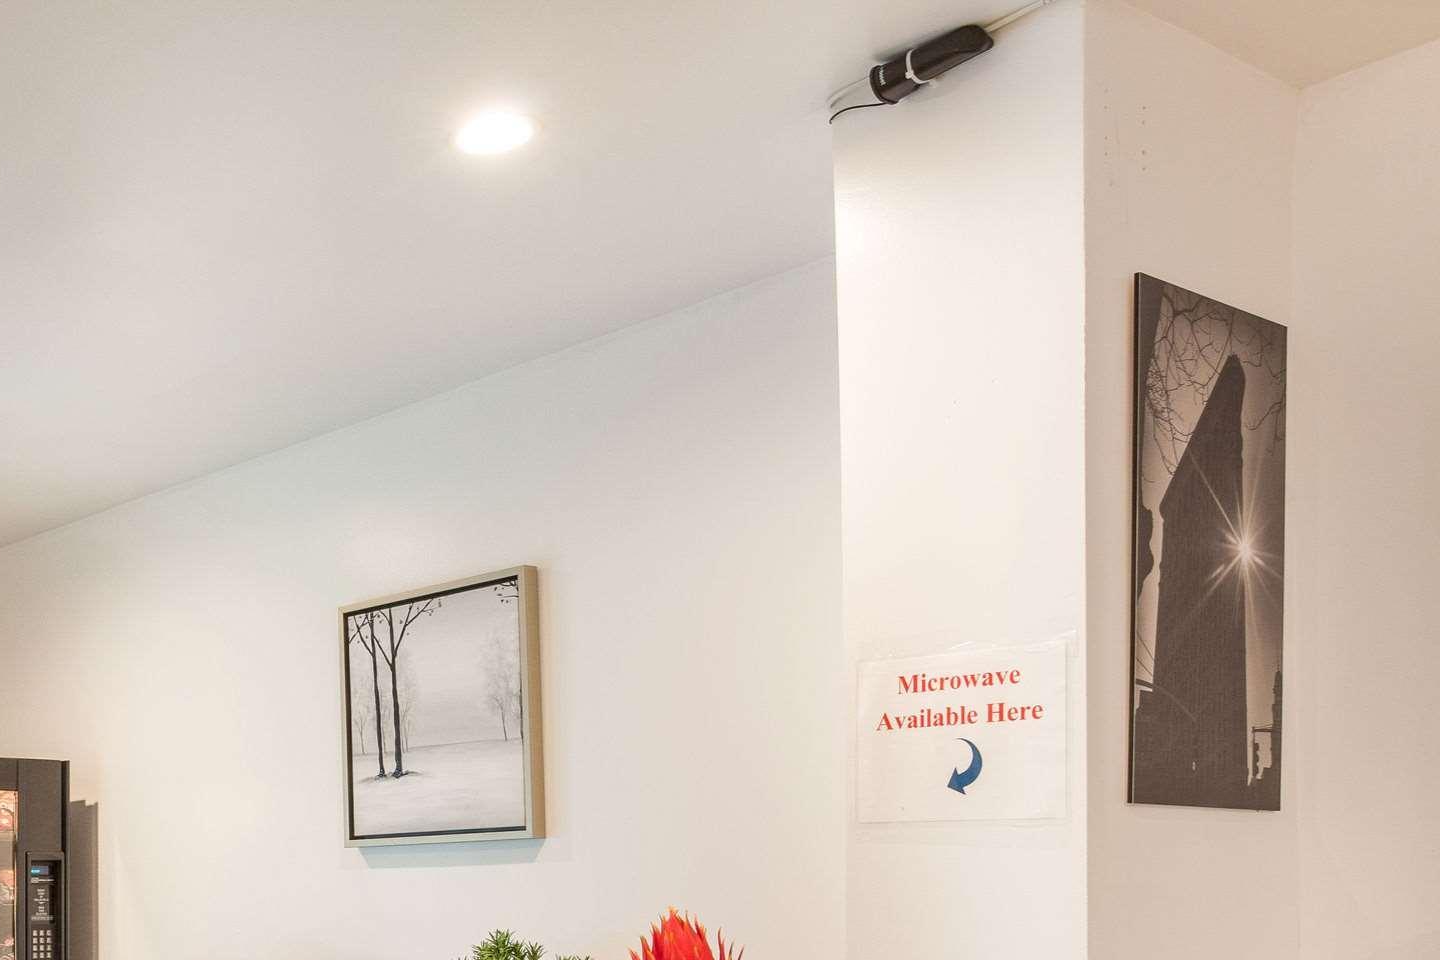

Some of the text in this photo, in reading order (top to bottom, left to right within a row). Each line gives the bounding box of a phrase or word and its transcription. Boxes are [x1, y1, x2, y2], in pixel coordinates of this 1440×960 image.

[897, 668, 1021, 695] Microwave
[876, 701, 1044, 731] Available Here
